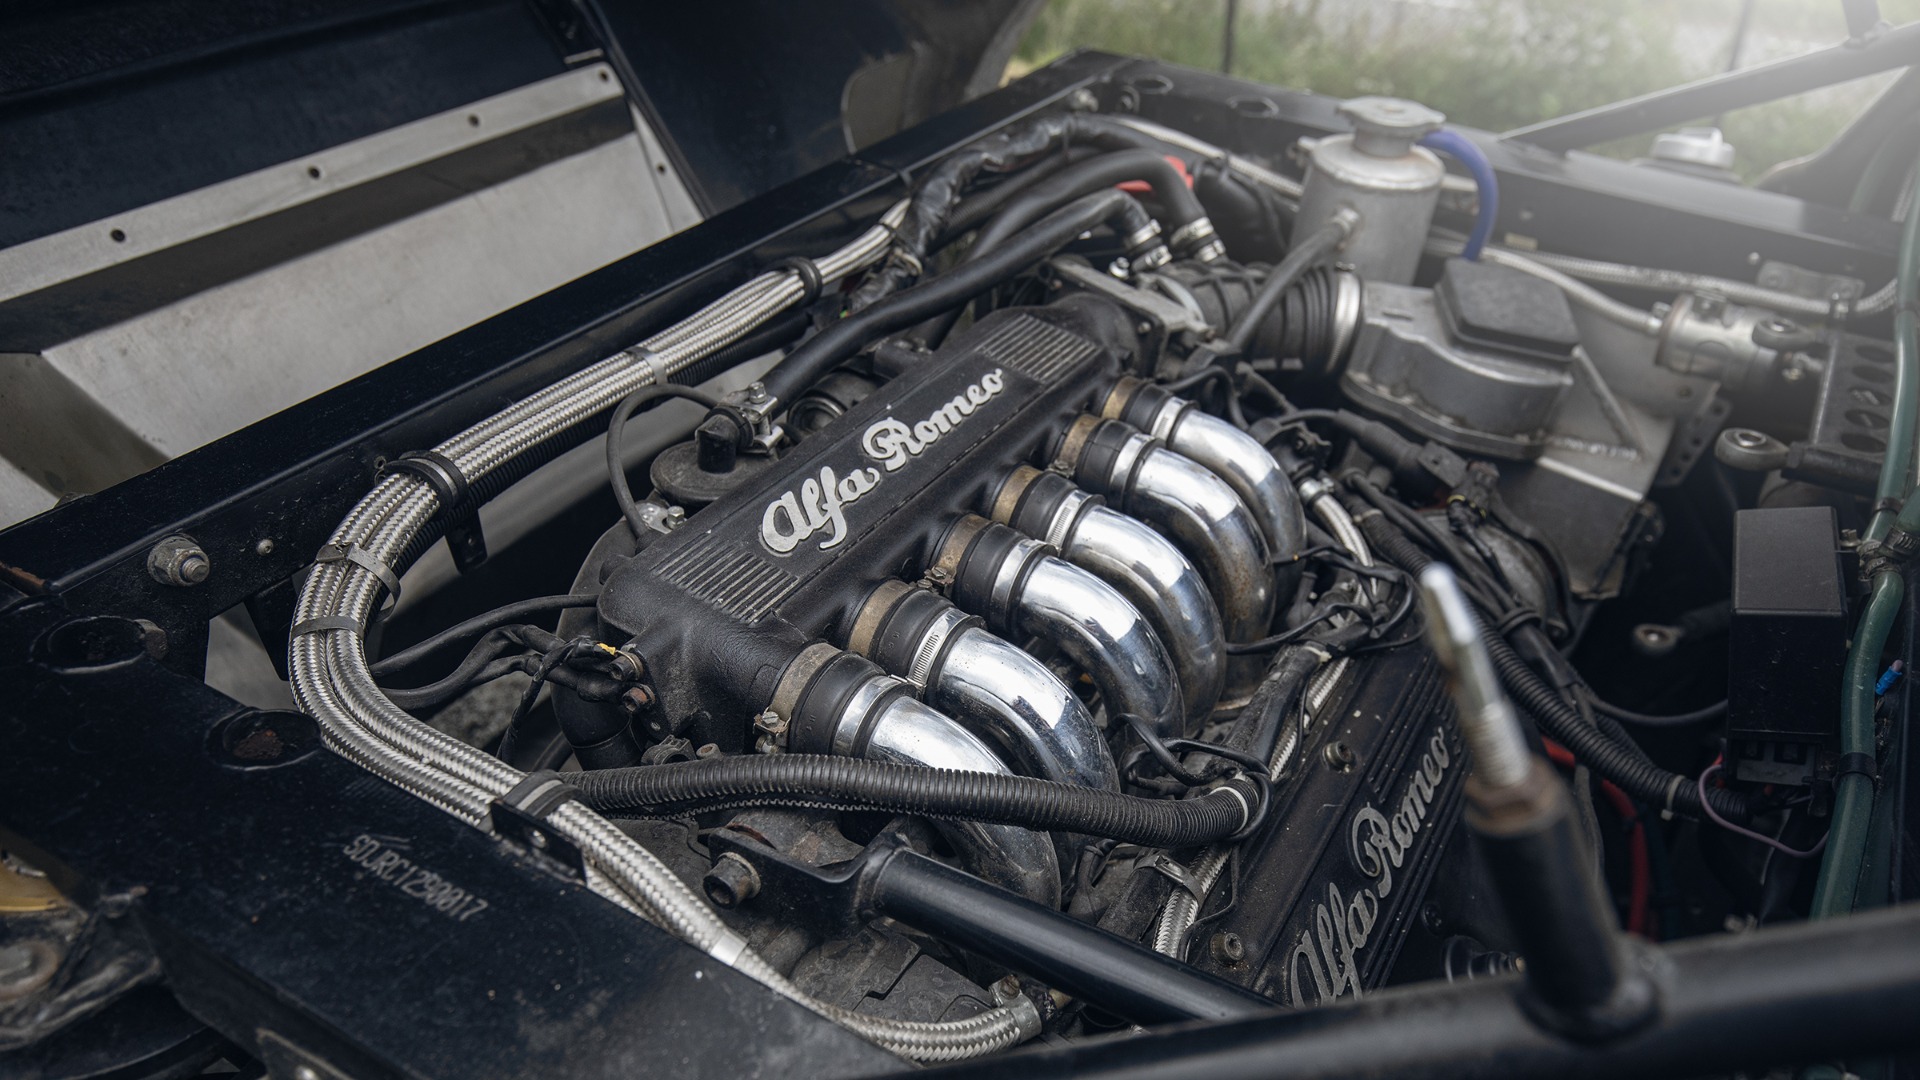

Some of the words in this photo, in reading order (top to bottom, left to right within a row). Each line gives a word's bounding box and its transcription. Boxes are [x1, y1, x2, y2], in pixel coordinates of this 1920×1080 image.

[762, 466, 880, 552] Alfa
[862, 368, 1003, 471] Romeo
[1352, 727, 1450, 898] Romeo
